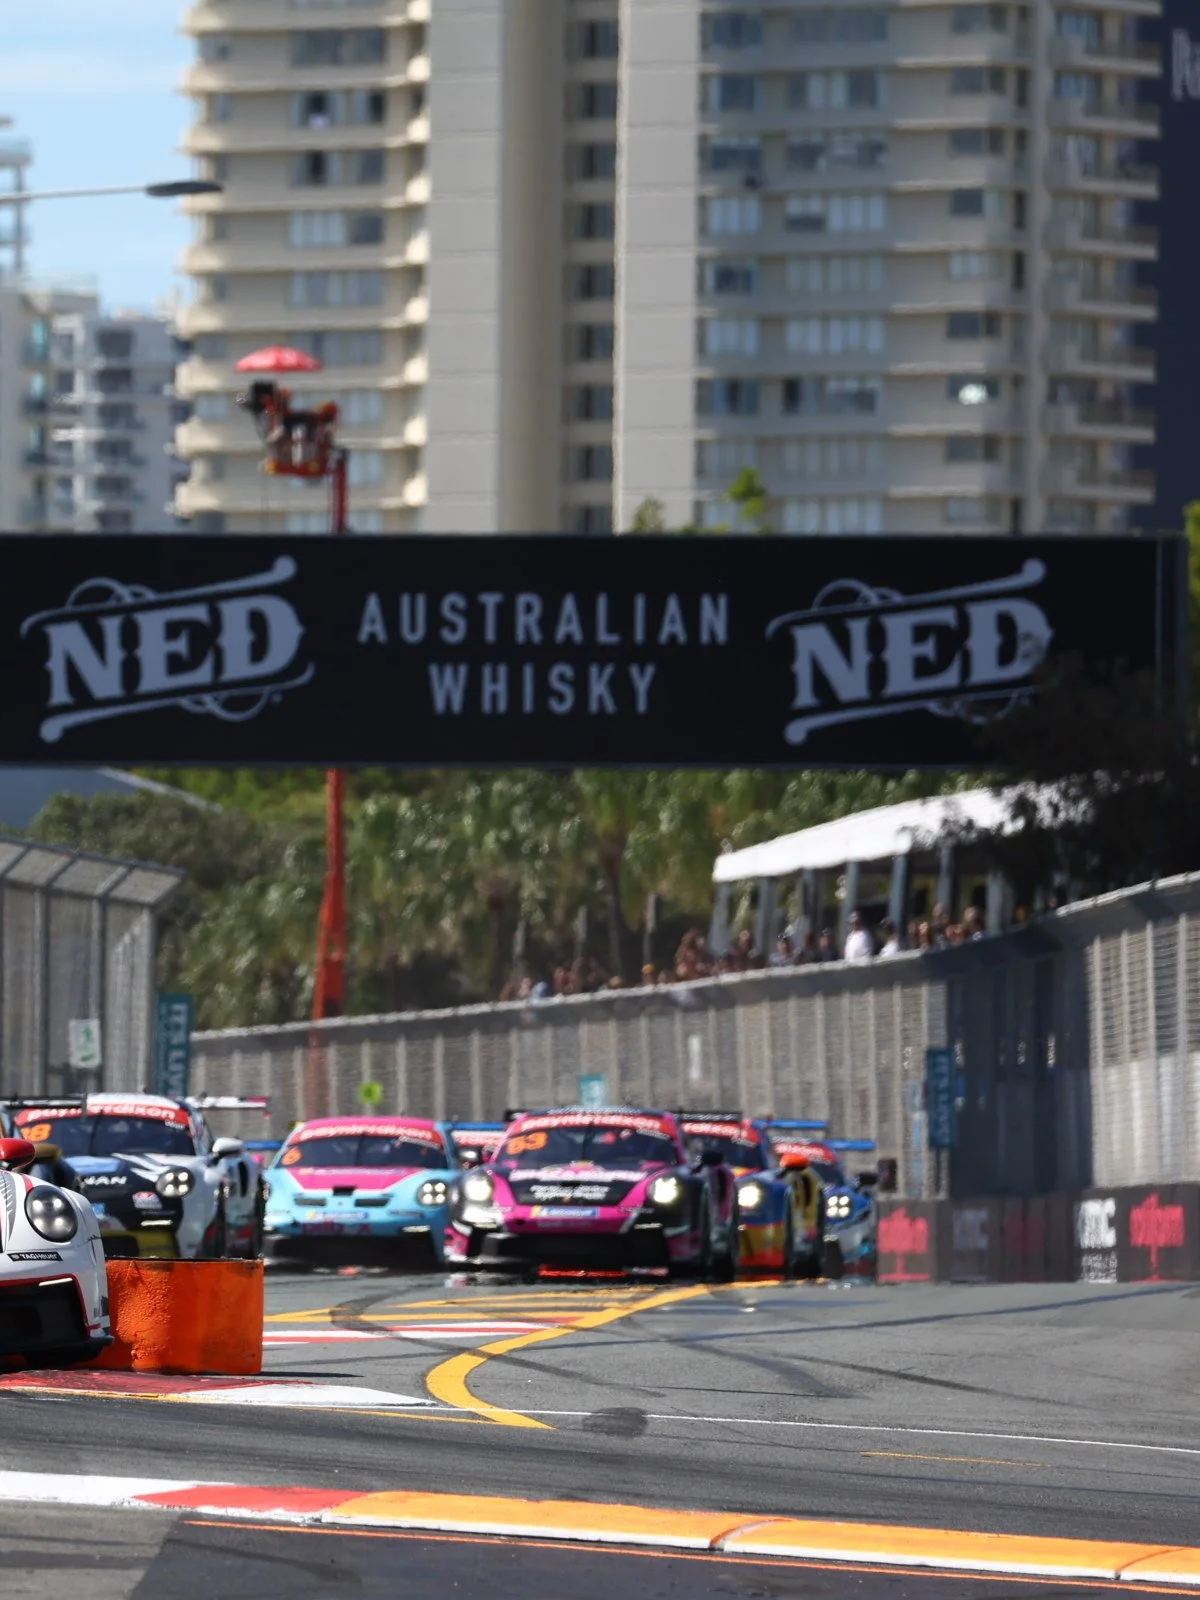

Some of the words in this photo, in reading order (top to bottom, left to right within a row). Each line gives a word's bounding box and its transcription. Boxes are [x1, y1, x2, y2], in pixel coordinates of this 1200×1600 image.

[44, 595, 305, 708] NED
[357, 592, 729, 645] AUSTRALIAN
[789, 598, 1054, 709] NED
[428, 662, 657, 715] WHISKY
